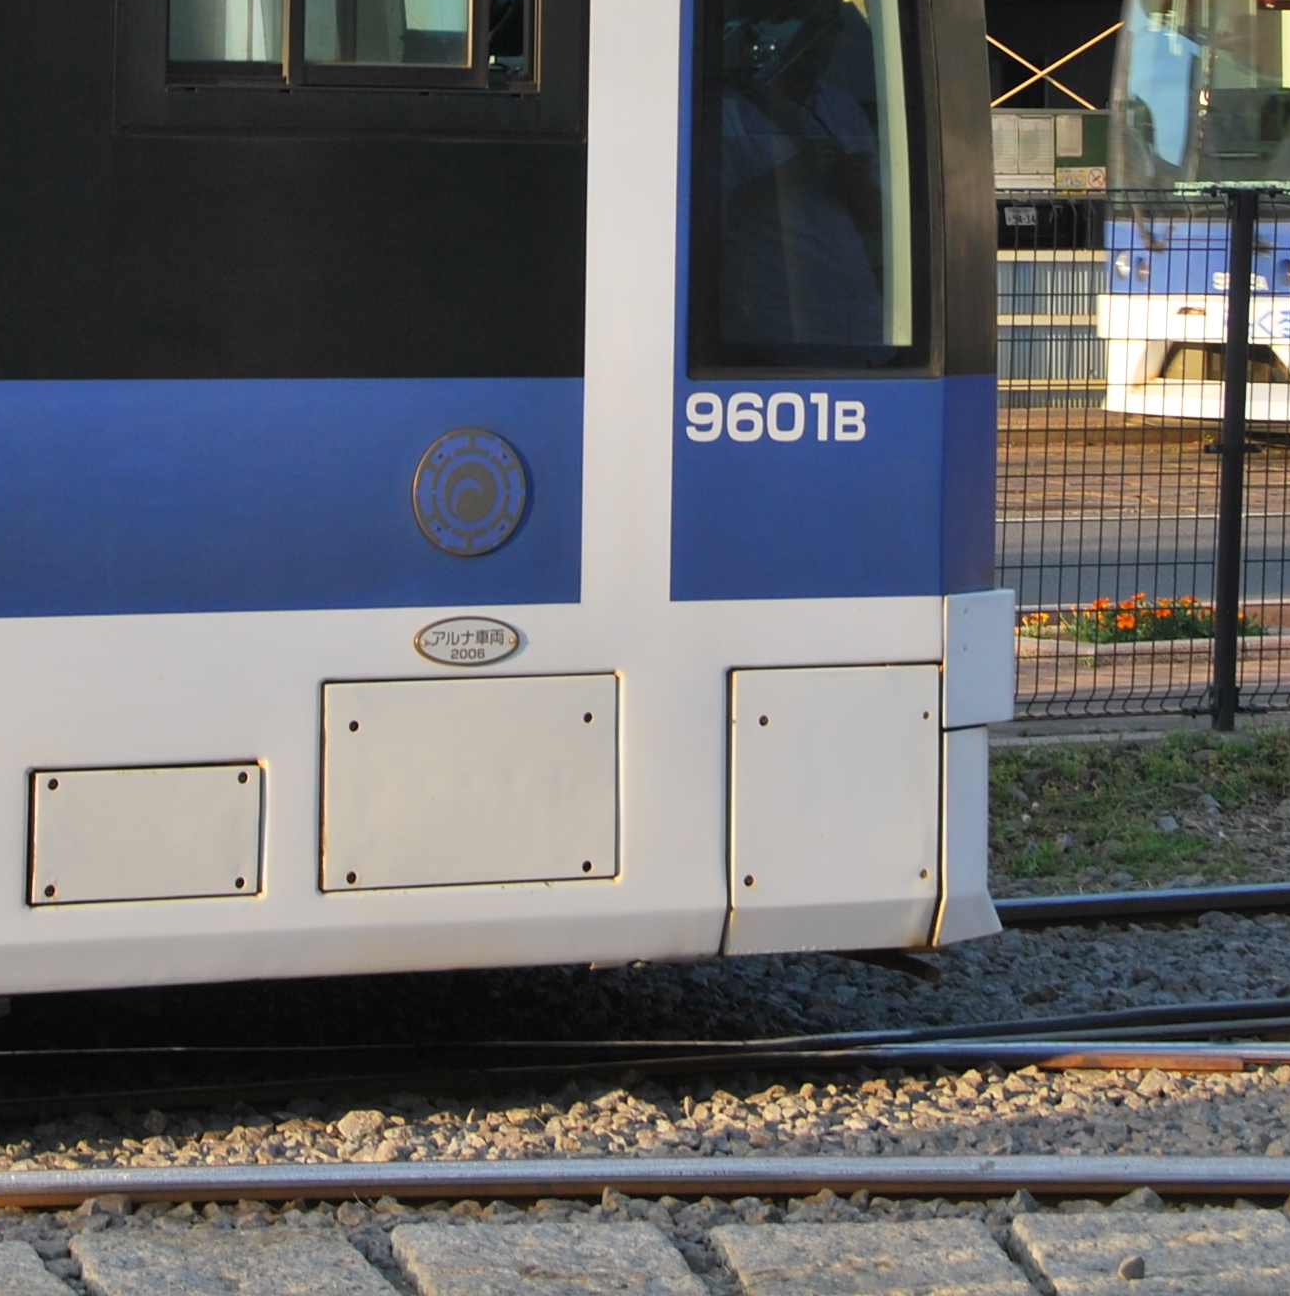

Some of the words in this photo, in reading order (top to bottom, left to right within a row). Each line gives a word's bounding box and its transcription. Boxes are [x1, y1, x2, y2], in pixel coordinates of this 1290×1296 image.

[685, 391, 867, 443] 9601B
[431, 628, 505, 646] アルナ車両
[450, 648, 486, 660] 2006
